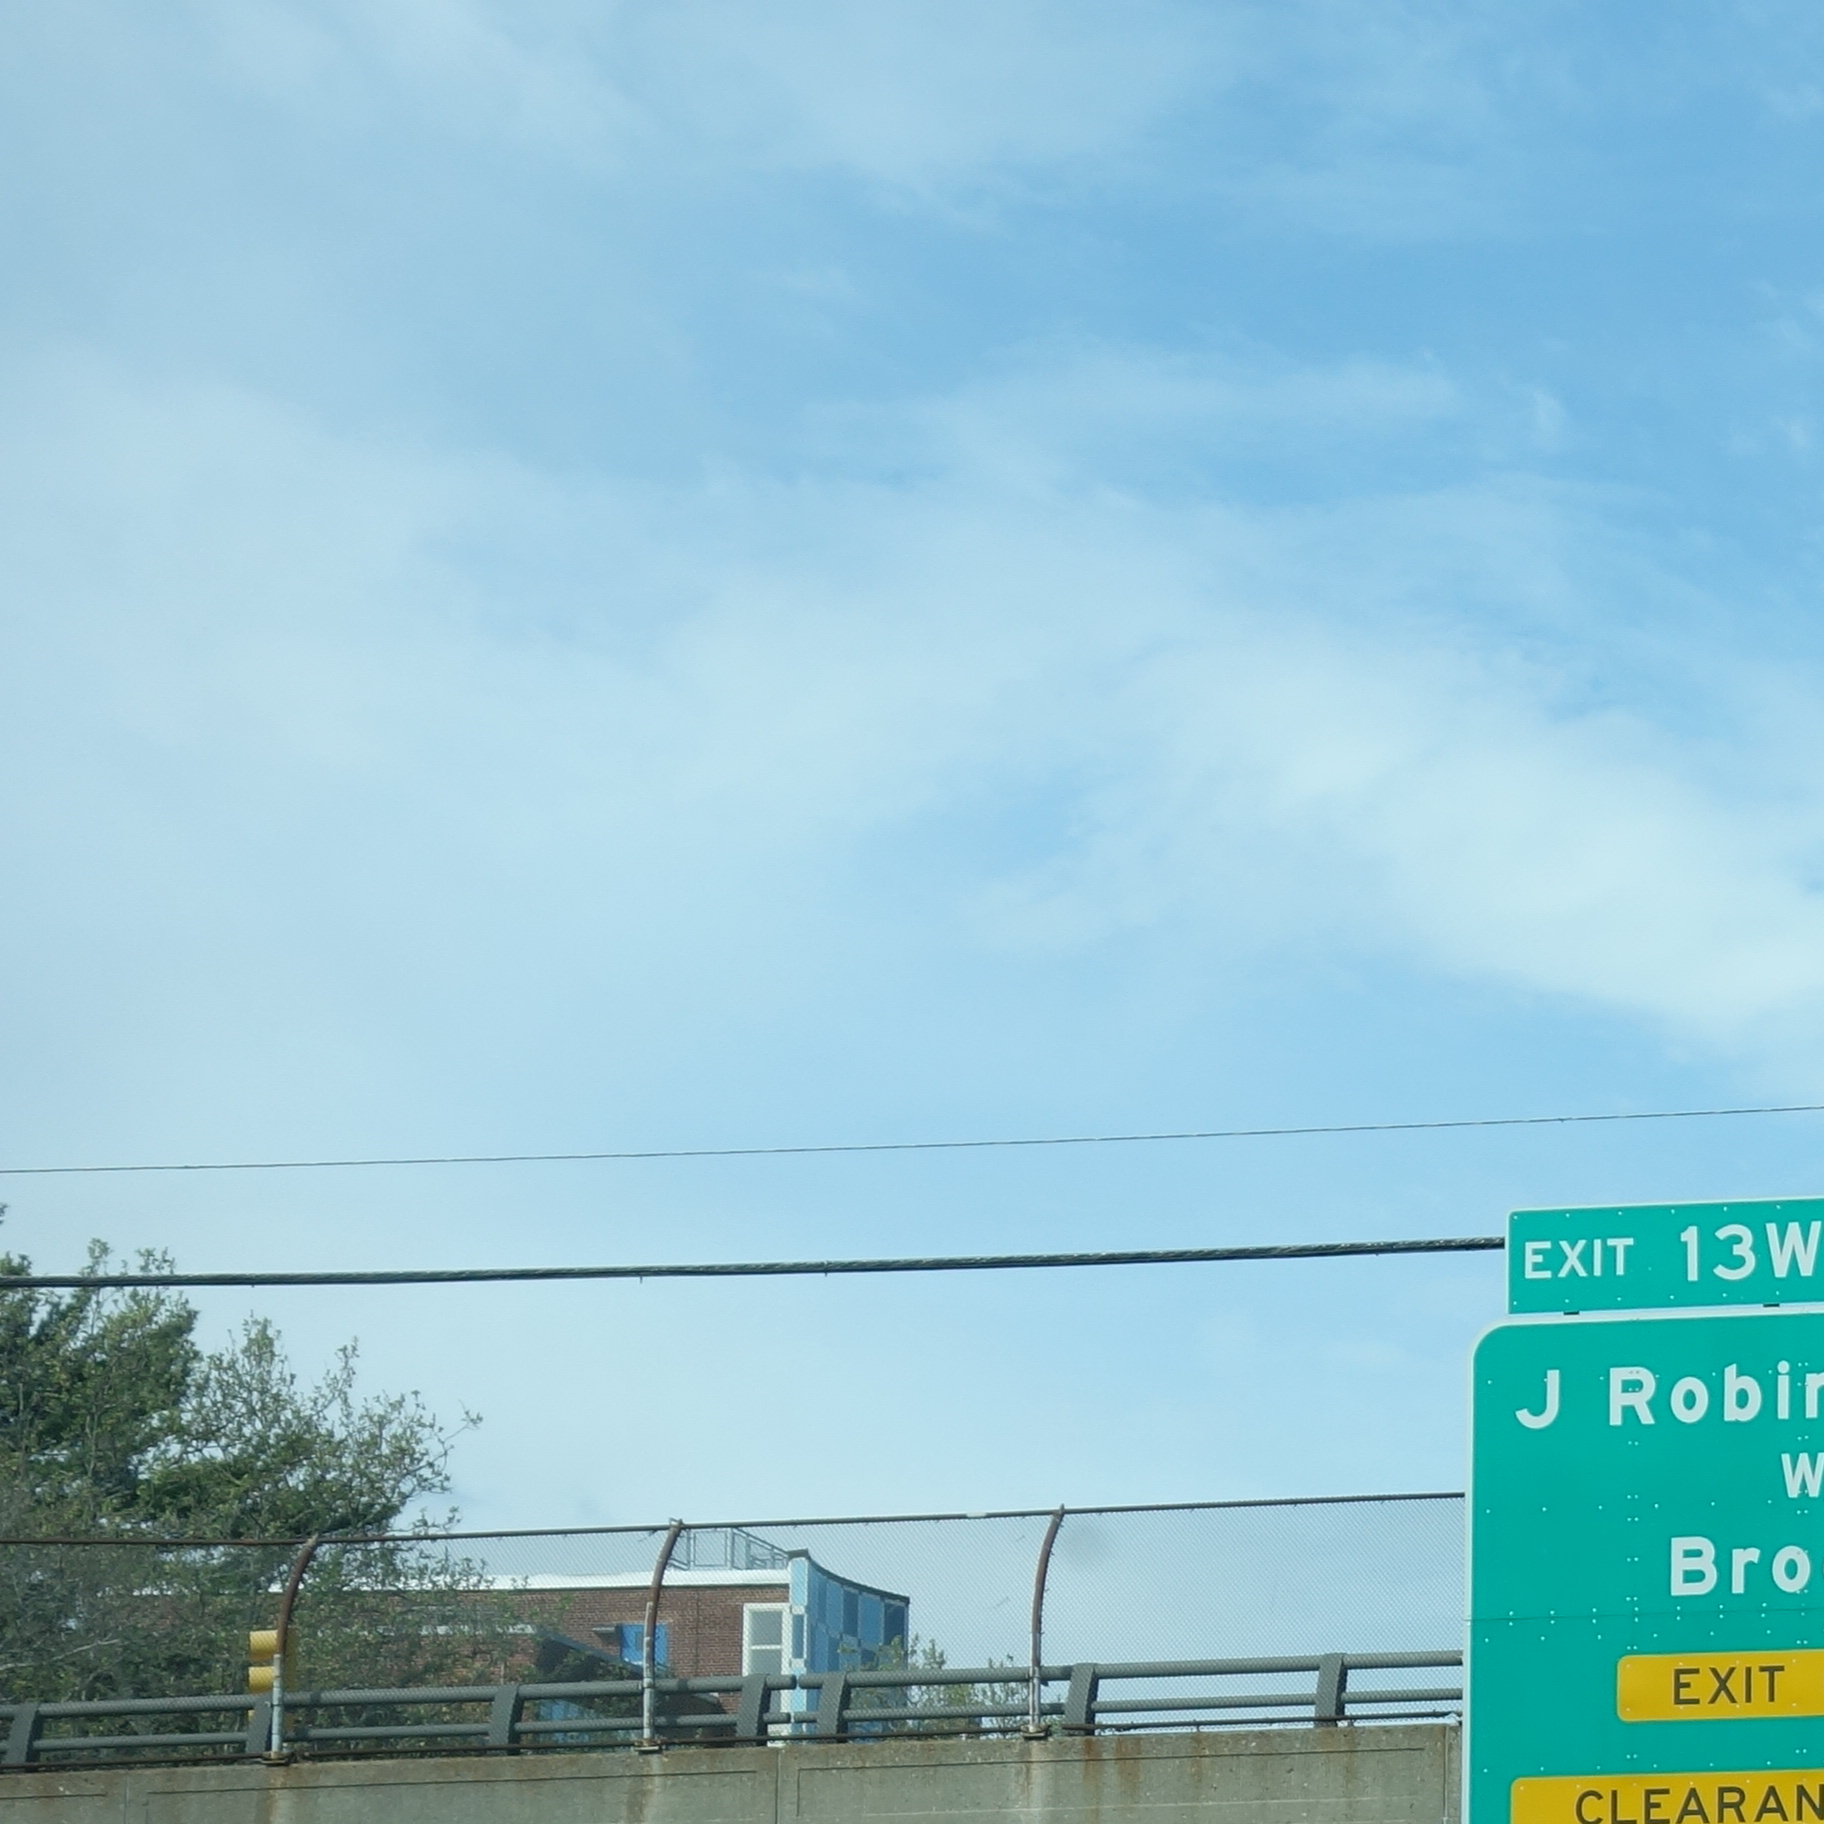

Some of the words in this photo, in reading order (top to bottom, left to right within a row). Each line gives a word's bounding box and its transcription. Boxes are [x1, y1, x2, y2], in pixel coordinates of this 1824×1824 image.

[1525, 1237, 1634, 1279] EXIT
[1680, 1221, 1822, 1282] 13W
[1515, 1369, 1560, 1429] J
[1673, 1665, 1785, 1706] EXIT
